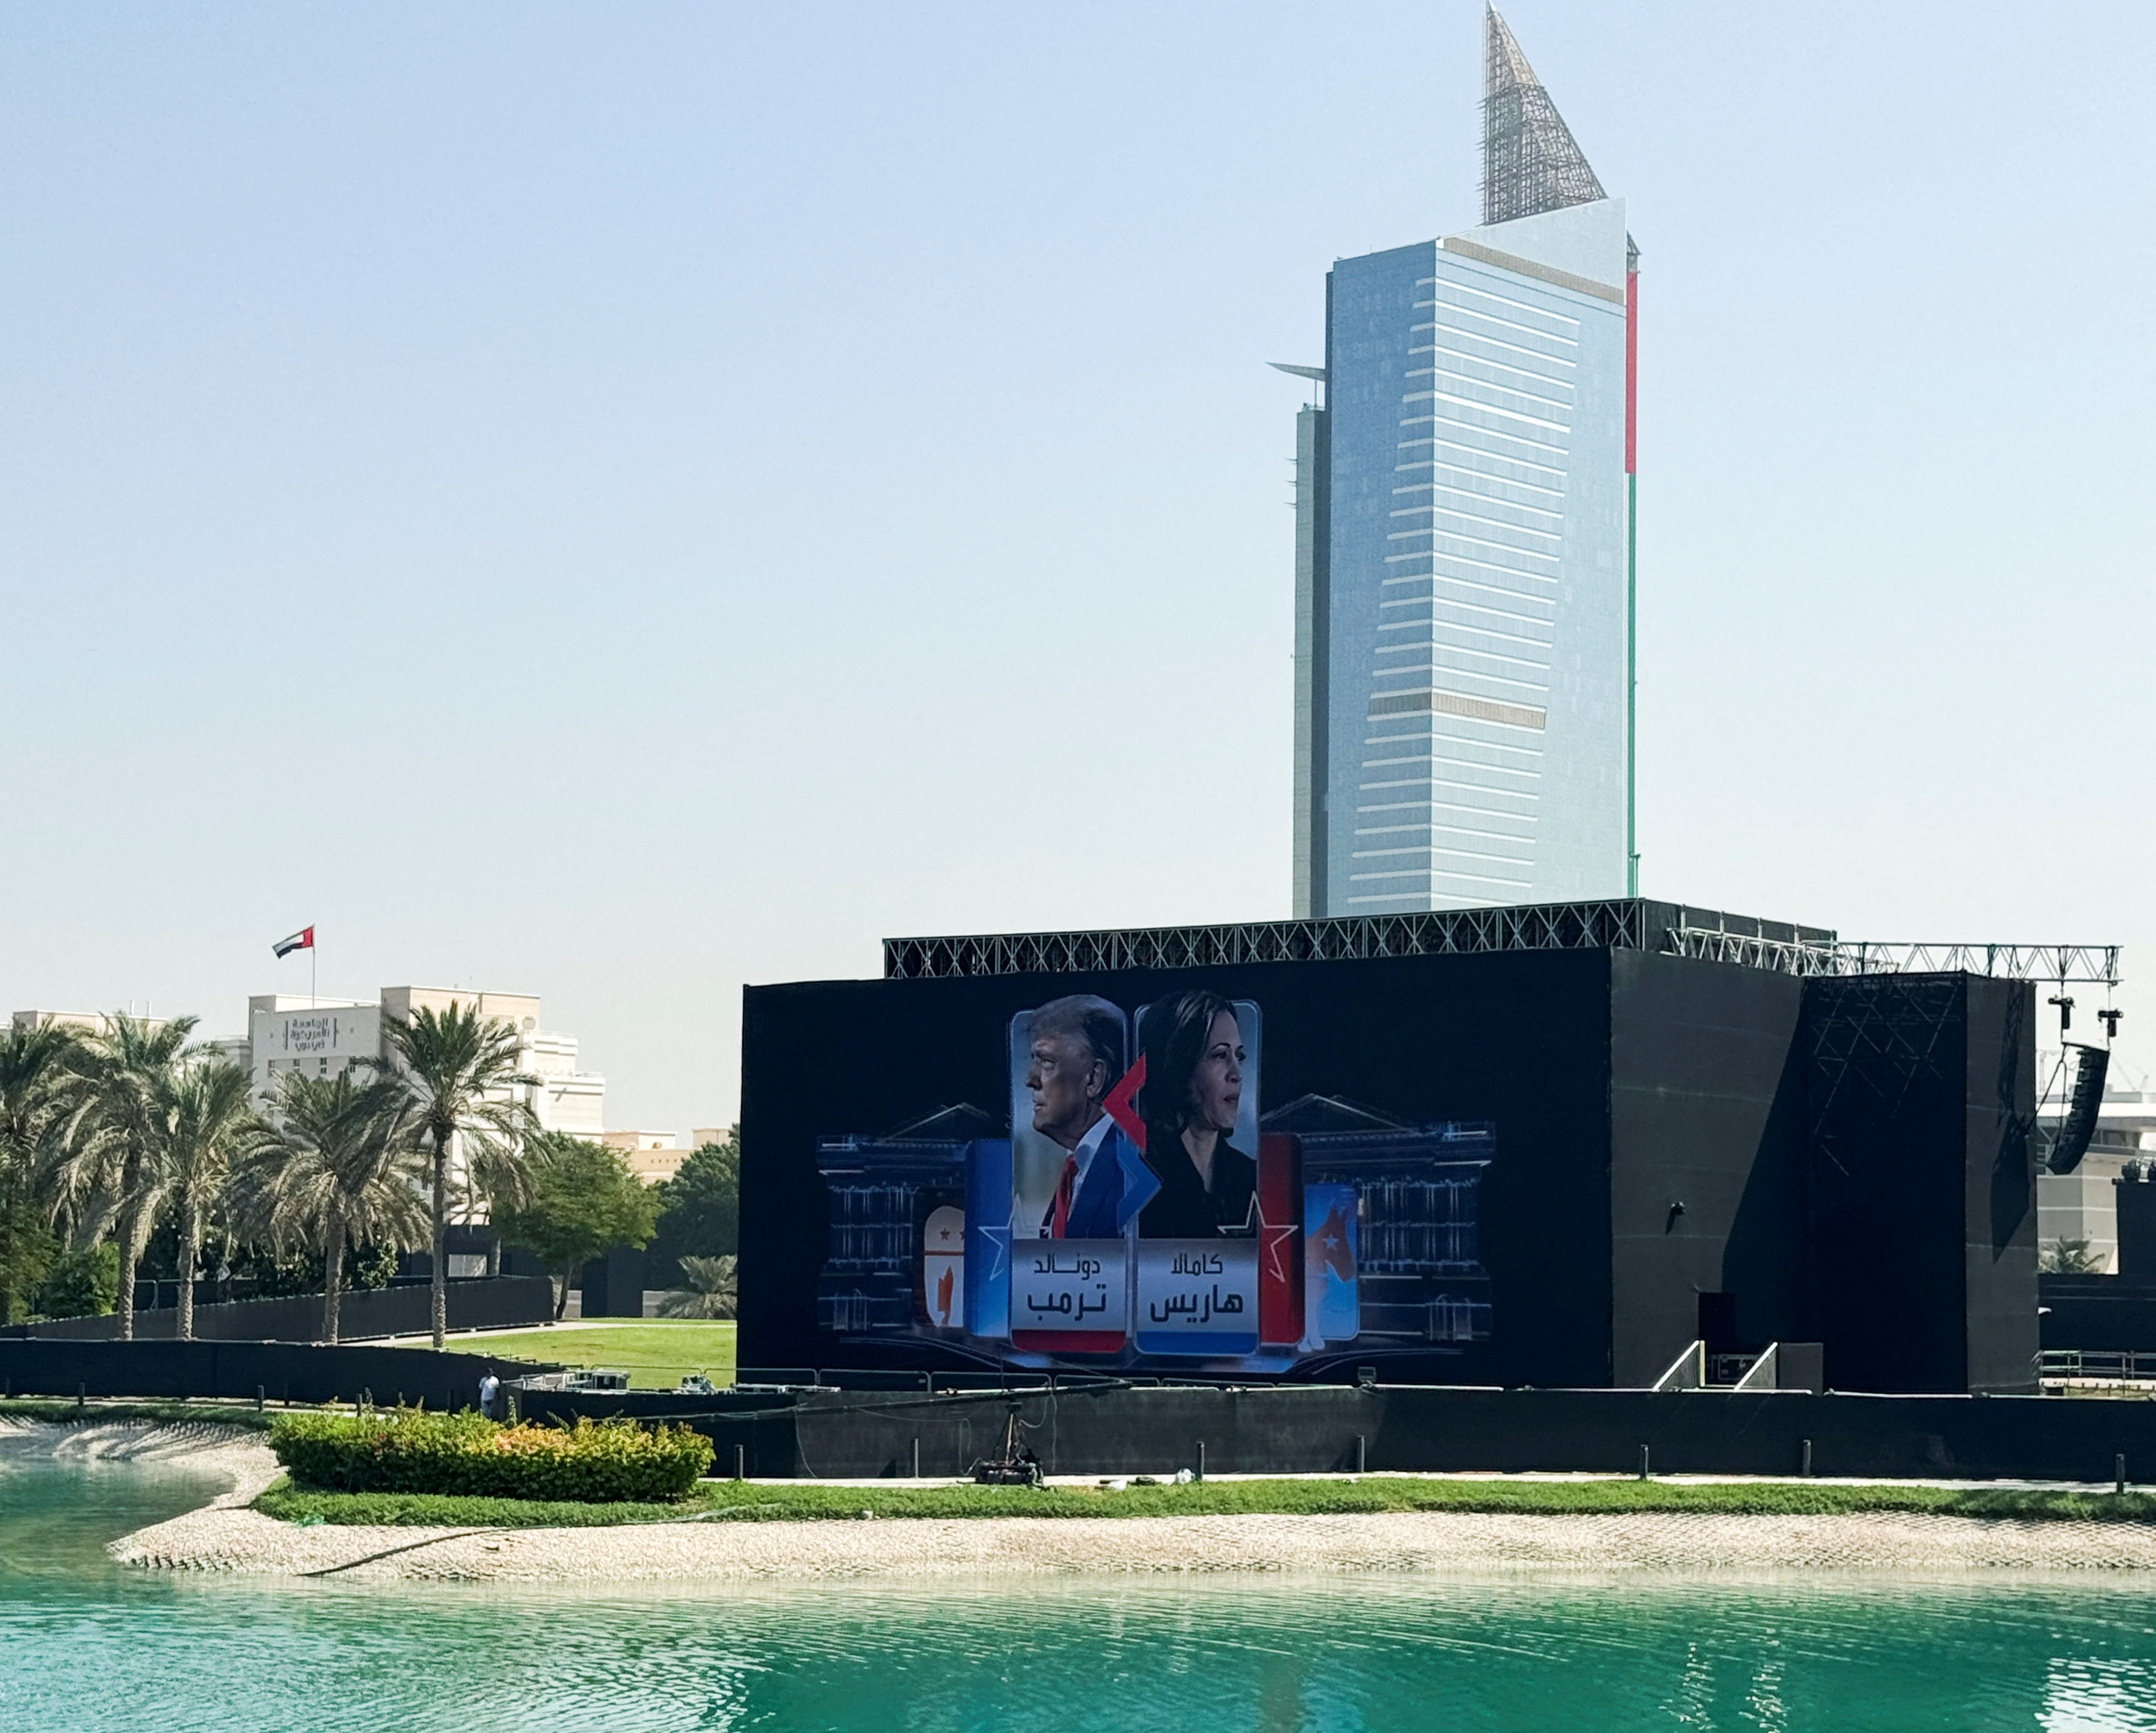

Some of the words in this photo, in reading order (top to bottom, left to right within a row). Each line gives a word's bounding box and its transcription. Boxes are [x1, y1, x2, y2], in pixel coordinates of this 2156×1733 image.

[312, 1039, 325, 1052] في
[1034, 1253, 1101, 1281] دونالد
[1171, 1253, 1223, 1277] كامالا
[1027, 1283, 1107, 1321] ترمب
[1150, 1284, 1244, 1323] هاريس
